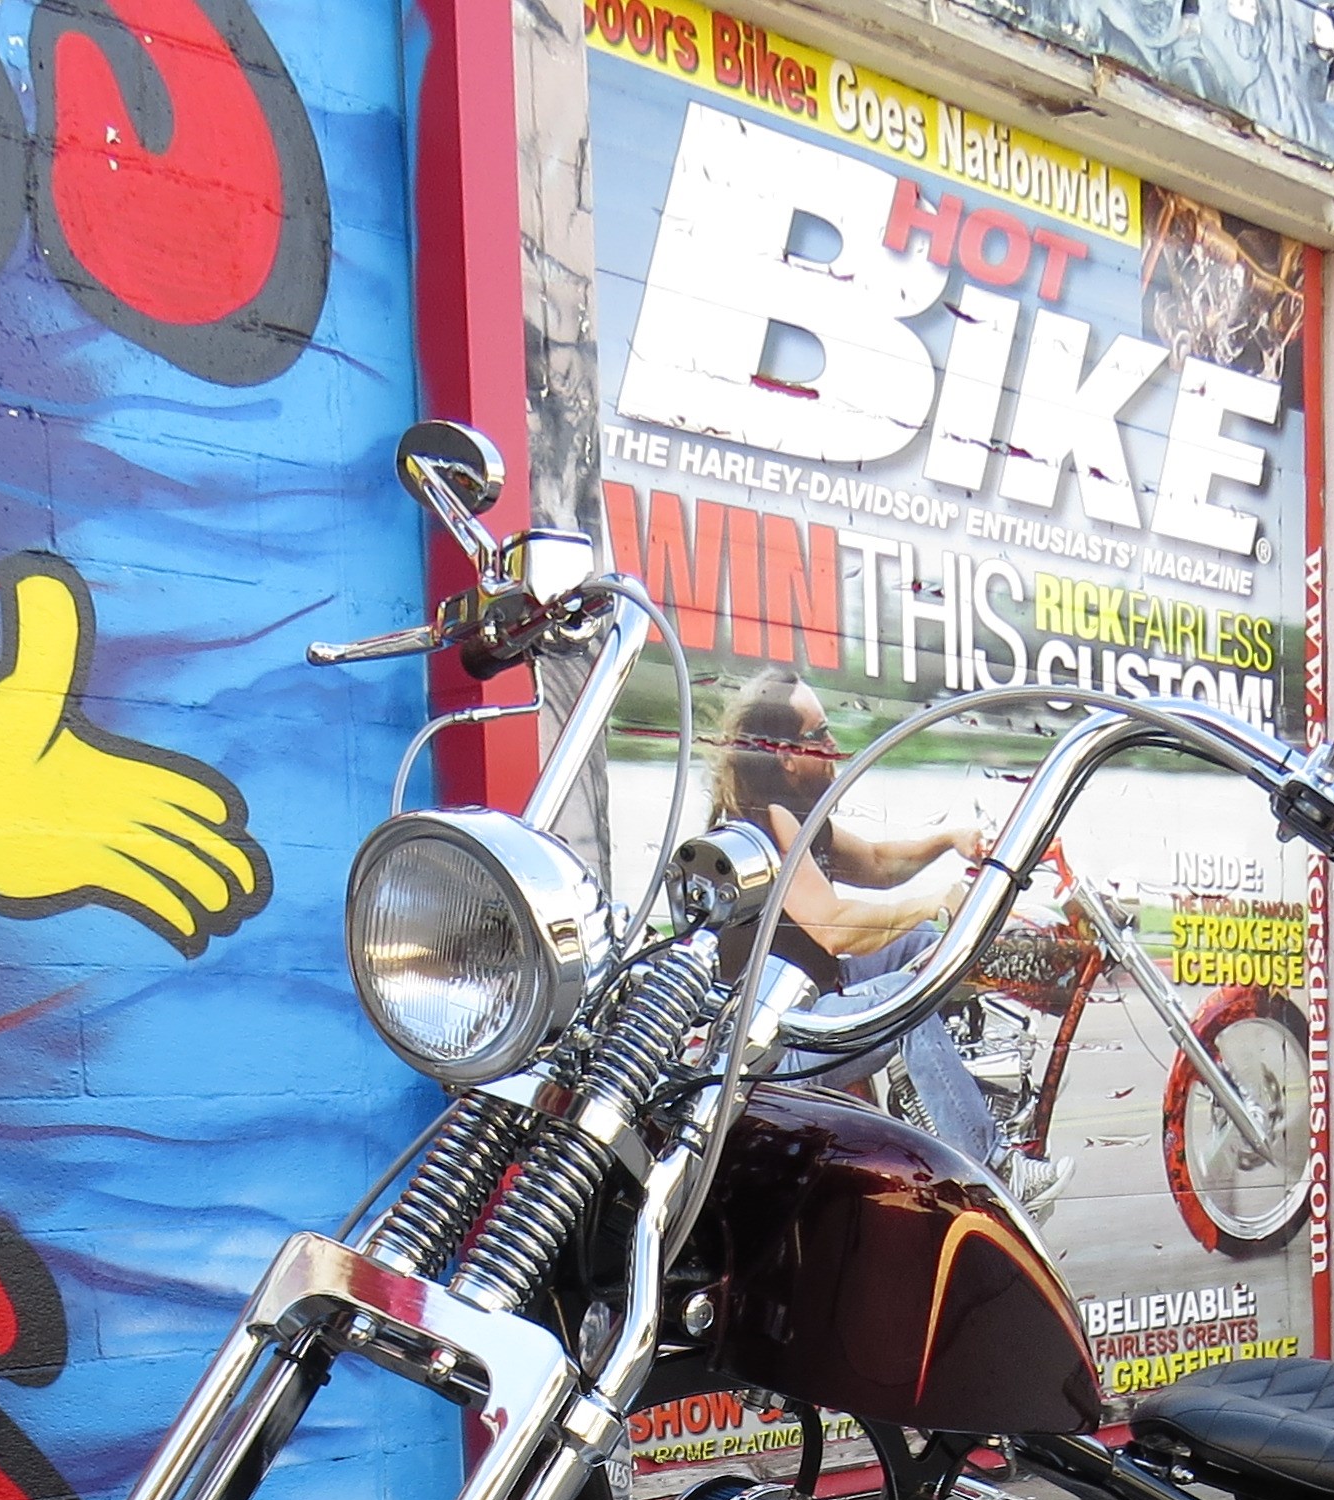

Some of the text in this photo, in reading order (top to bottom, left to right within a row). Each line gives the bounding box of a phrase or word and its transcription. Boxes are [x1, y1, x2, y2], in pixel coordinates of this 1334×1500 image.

[584, 0, 1129, 235] oors Bike: Goes Nationwide
[882, 176, 1089, 302] HOT
[603, 424, 671, 469] THE
[1143, 547, 1253, 596] MAGAZINE
[601, 479, 1028, 692] WIN THIS
[1034, 571, 1274, 672] RICK FAIRLESS
[1172, 851, 1264, 893] INSIDE:
[1170, 892, 1304, 922] THE WORLD FAMOUS
[1172, 915, 1304, 954] STROKERS
[1172, 950, 1304, 988] ICEHOUSE
[1095, 1318, 1259, 1362] FAIRLESS CREATES
[629, 1391, 744, 1443] SHOW
[722, 1425, 803, 1456] PLATING
